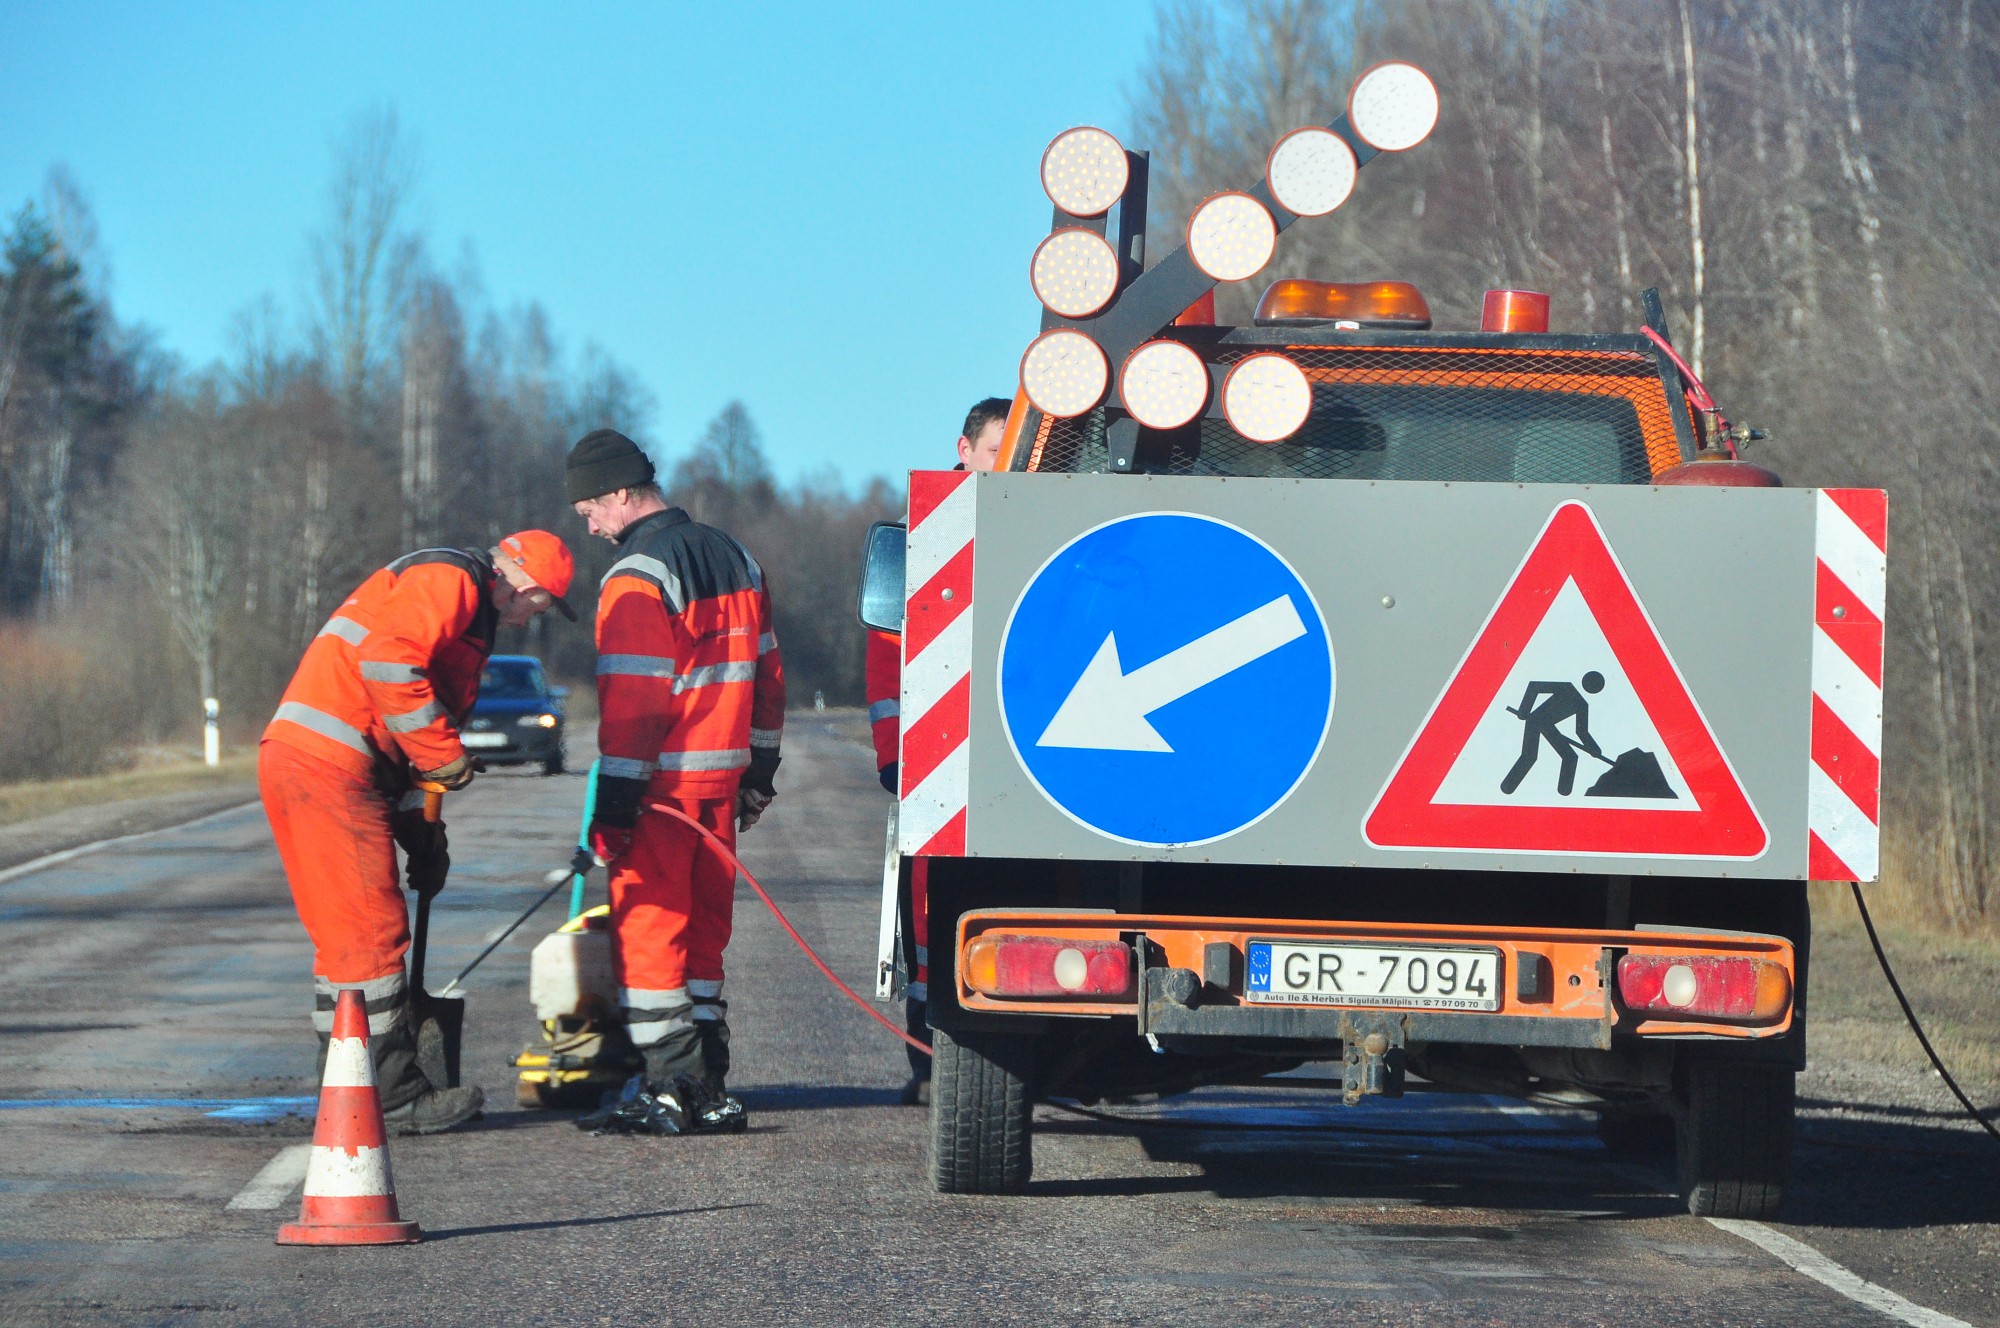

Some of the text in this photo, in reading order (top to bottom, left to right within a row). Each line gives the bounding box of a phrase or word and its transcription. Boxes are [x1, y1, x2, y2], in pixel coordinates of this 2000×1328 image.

[1251, 973, 1268, 985] LV
[1302, 994, 1309, 1002] &
[1312, 995, 1344, 1003] Herbst
[1348, 997, 1380, 1005] Sigulda
